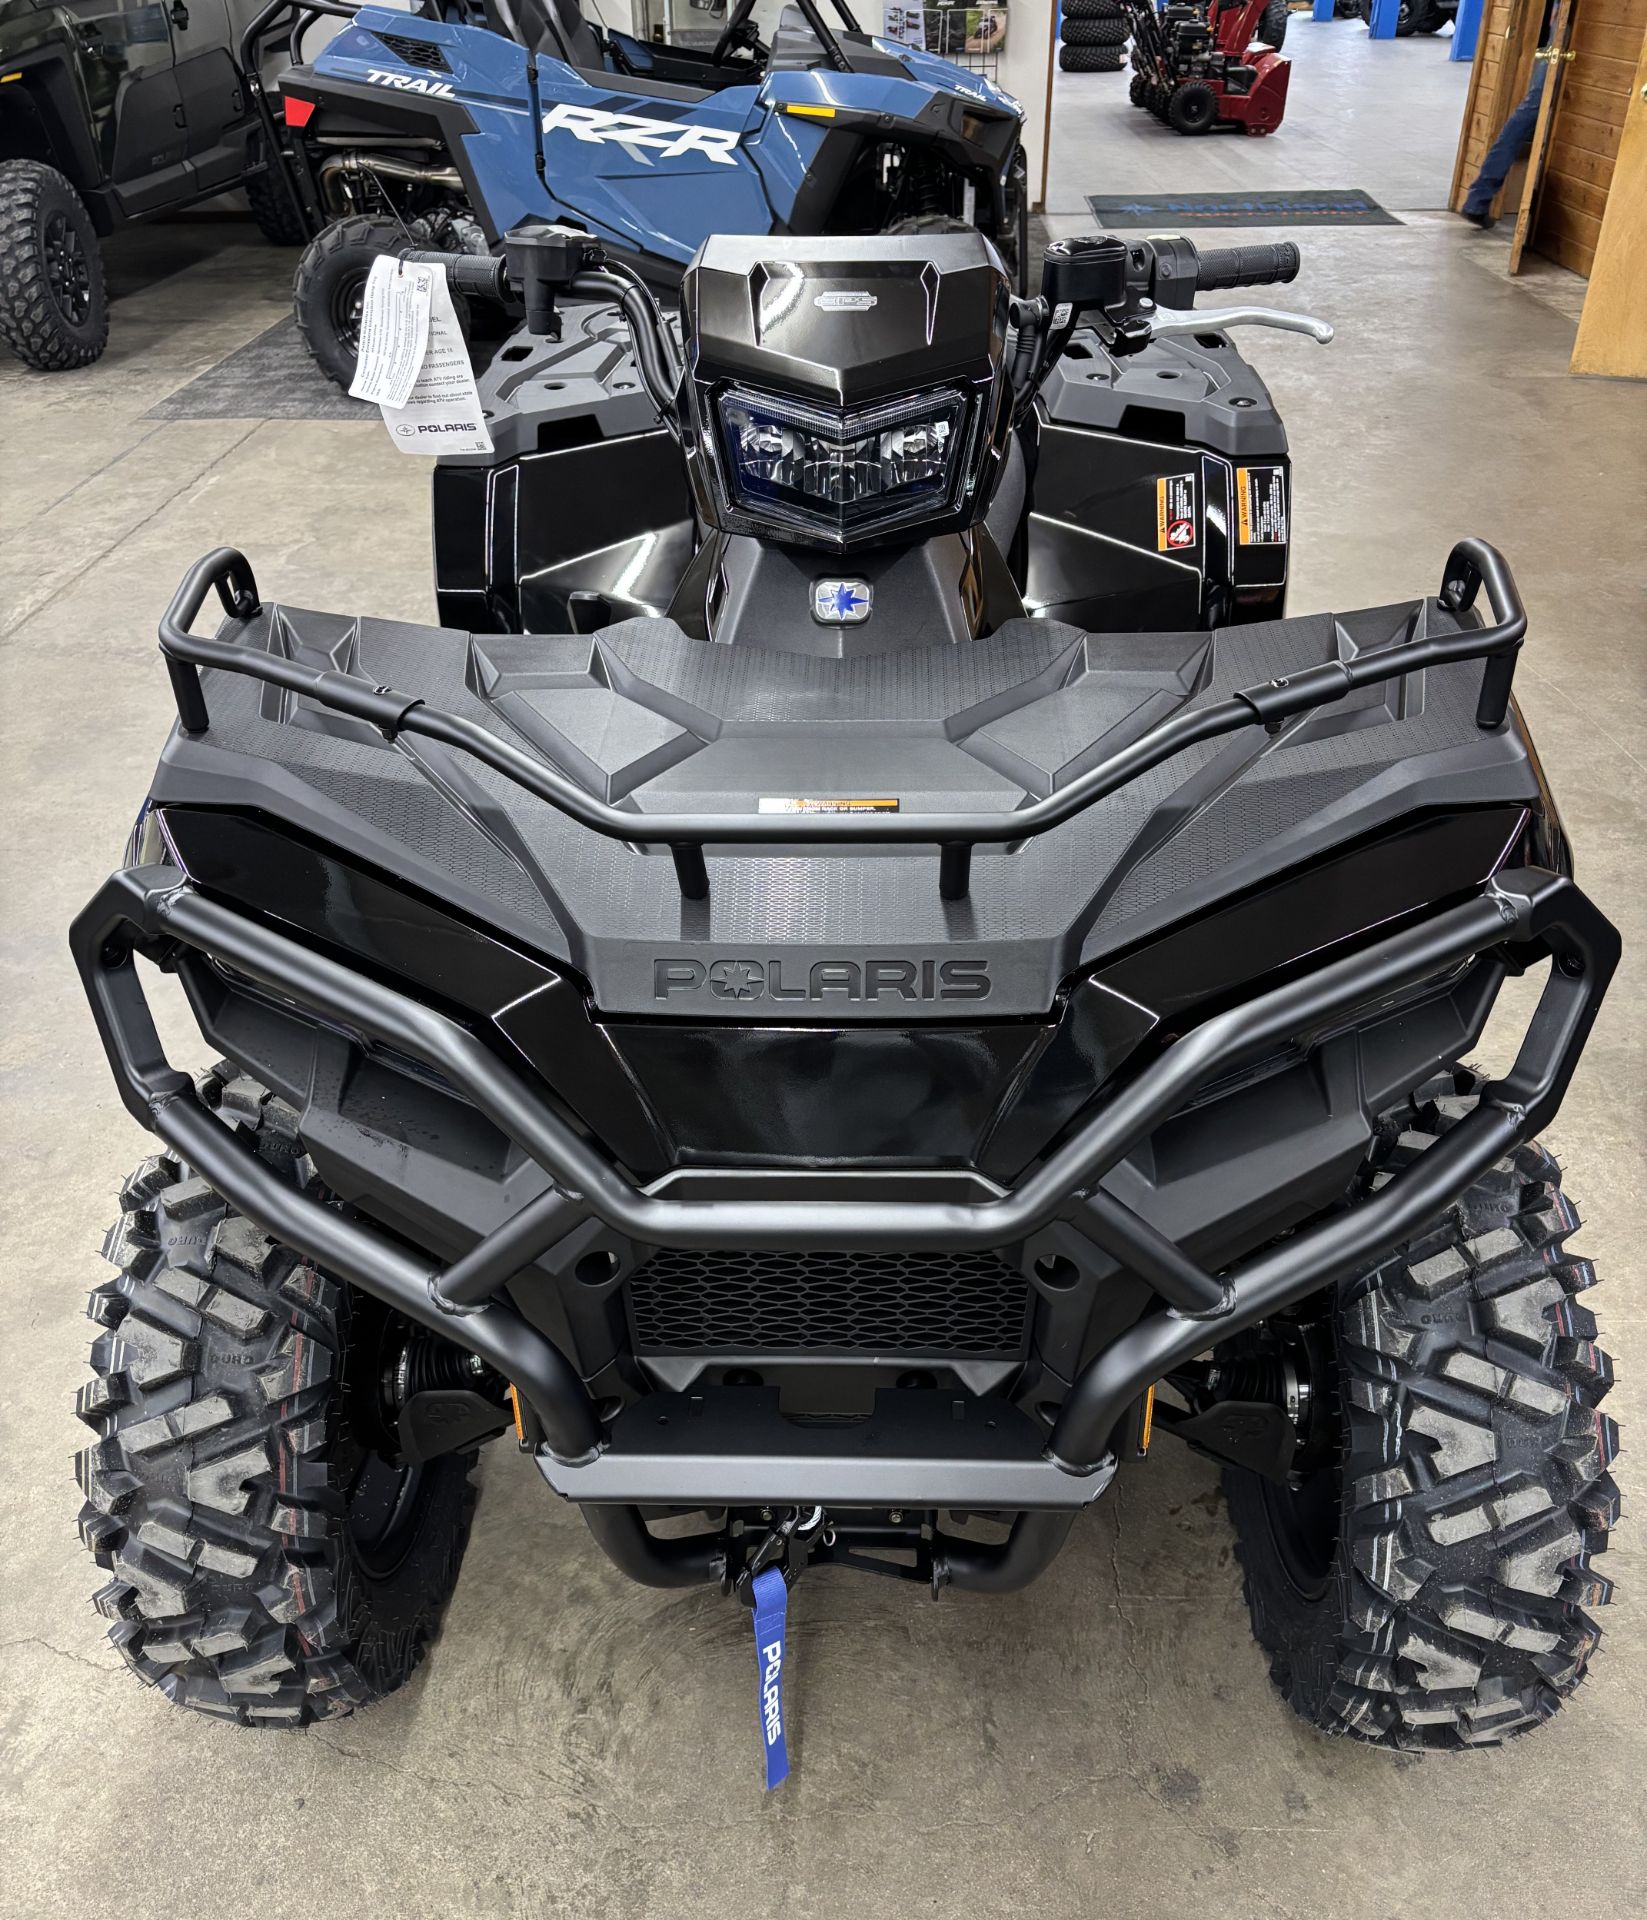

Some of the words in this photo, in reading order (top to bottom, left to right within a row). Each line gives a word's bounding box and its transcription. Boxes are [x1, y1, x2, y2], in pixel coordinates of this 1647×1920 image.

[367, 69, 455, 98] TRAIL
[954, 84, 987, 102] TRAIL
[542, 103, 741, 166] RZR
[428, 360, 465, 370] PASSENGERS
[417, 422, 477, 433] POLARIS
[653, 958, 992, 1001] POLARIS
[762, 1640, 782, 1746] POLARIS
